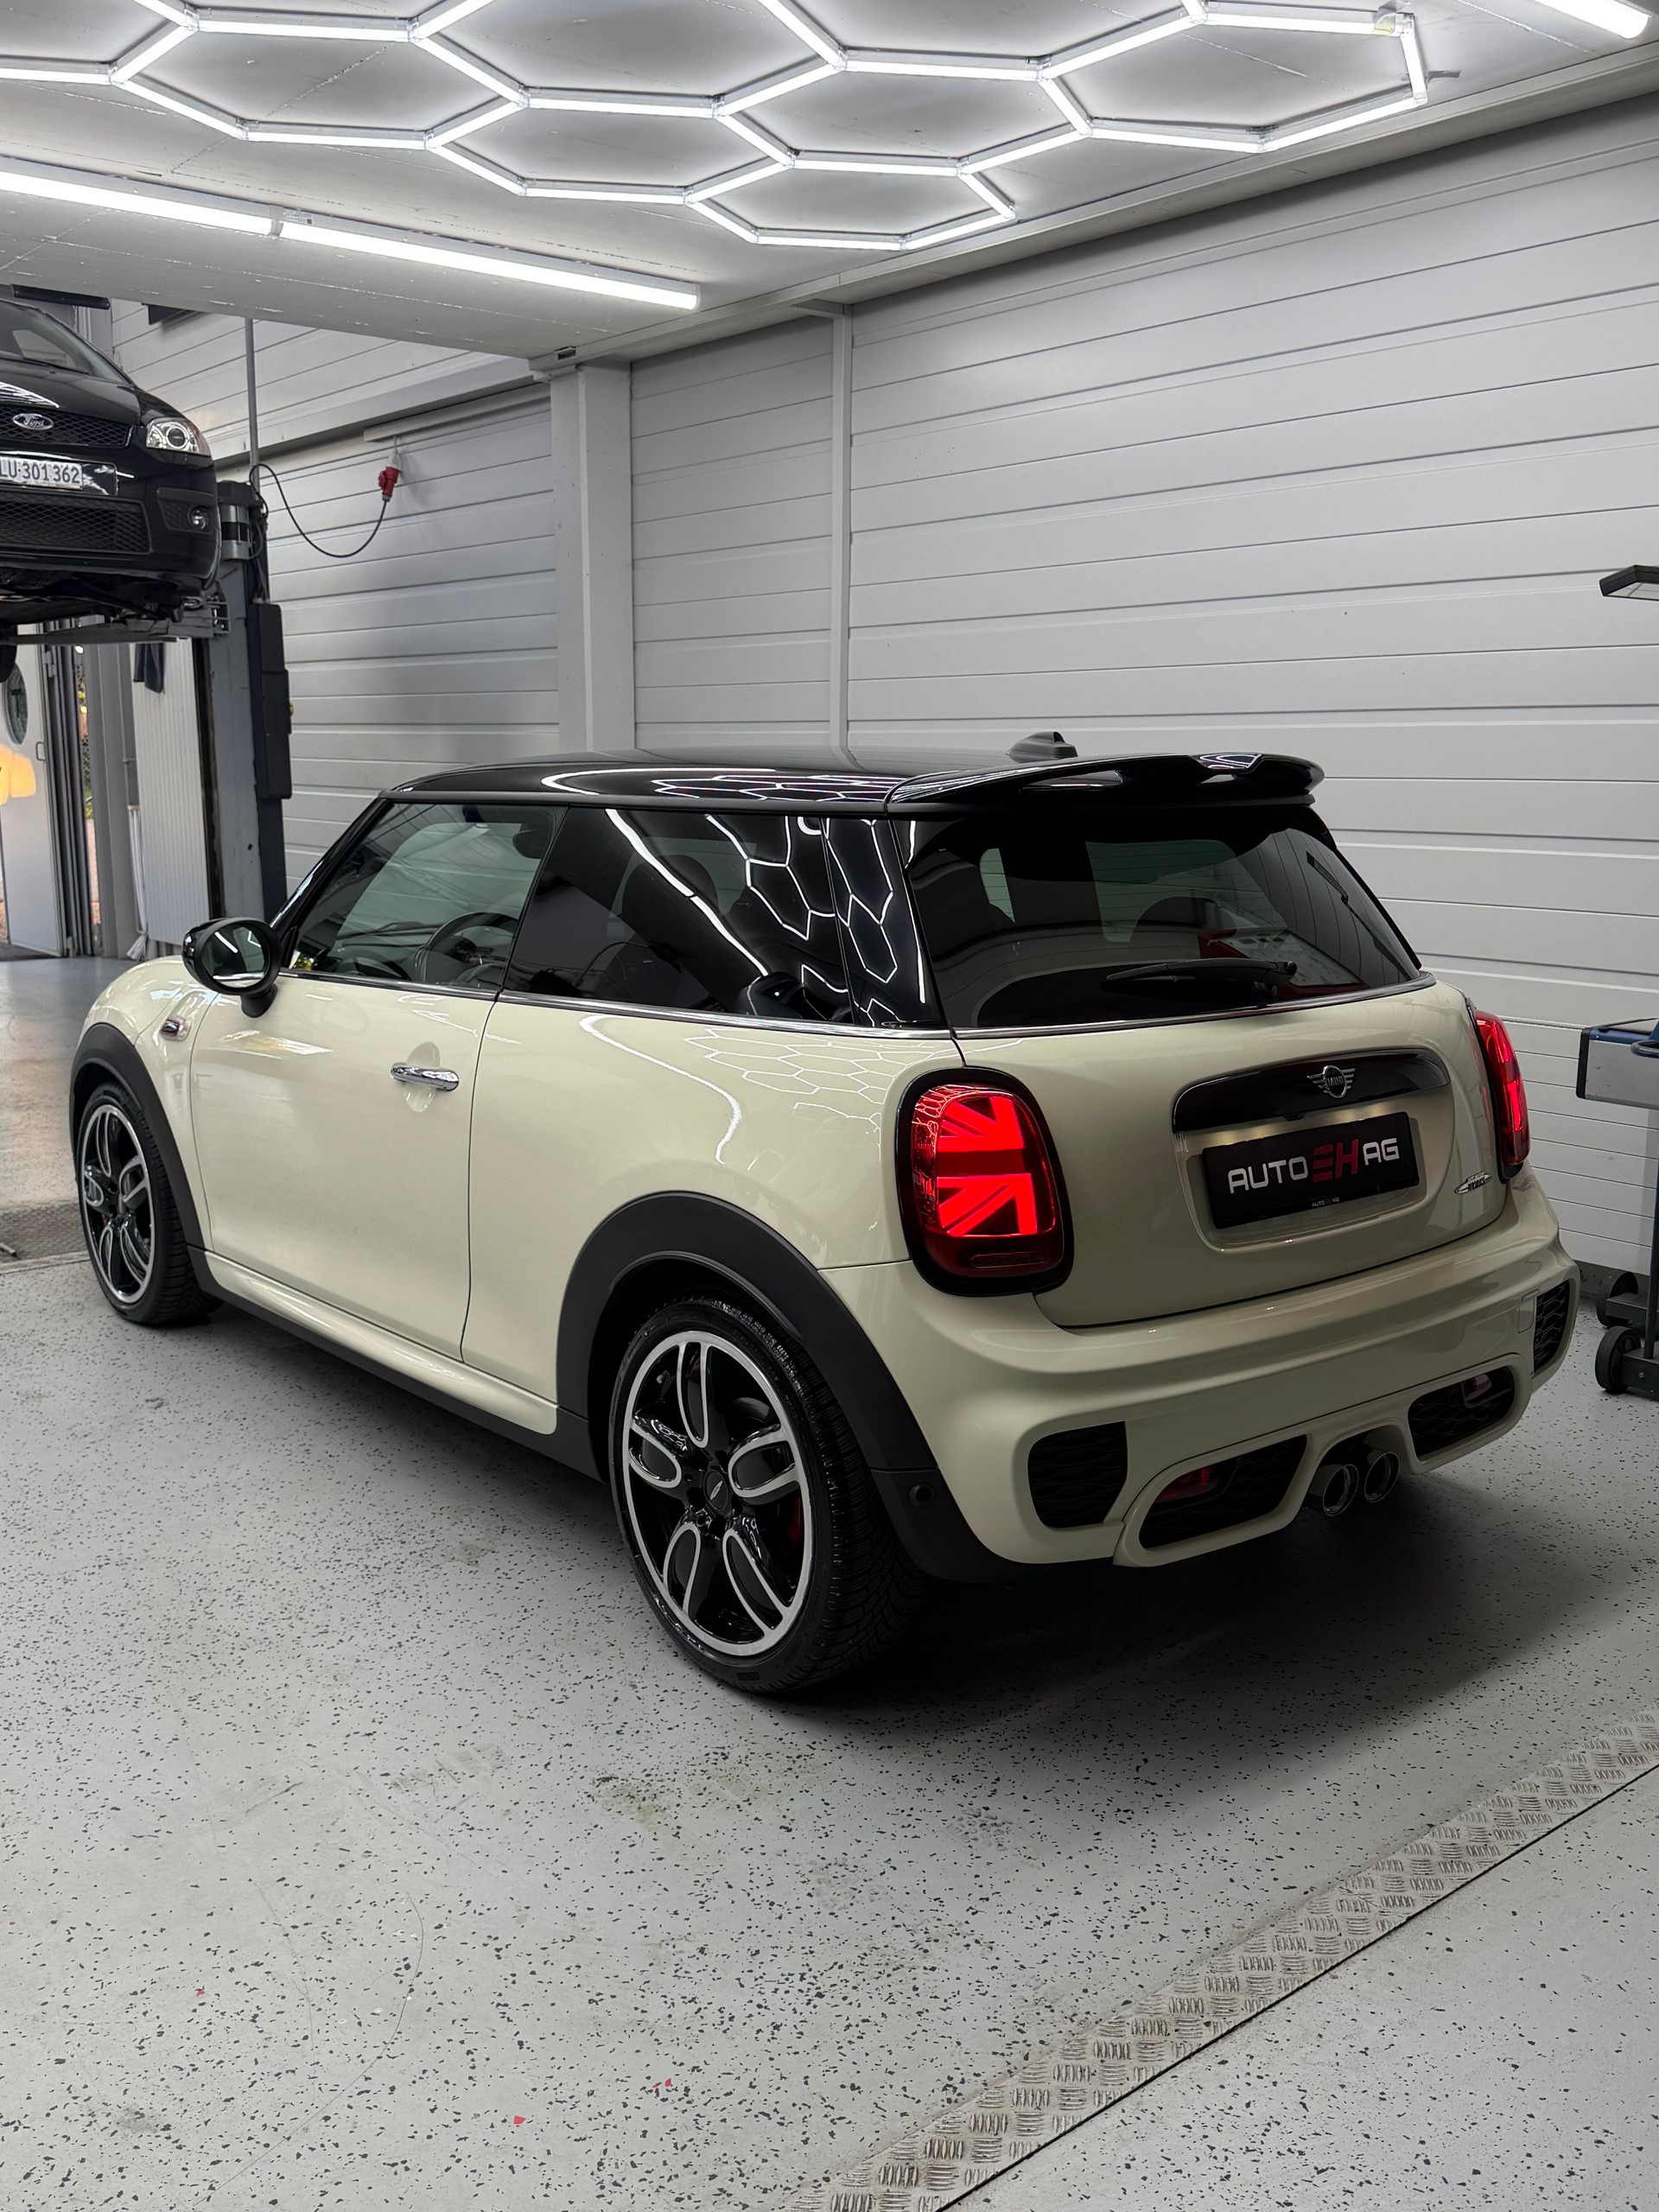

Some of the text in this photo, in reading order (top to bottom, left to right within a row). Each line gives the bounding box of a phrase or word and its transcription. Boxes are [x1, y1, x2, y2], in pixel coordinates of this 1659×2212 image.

[1327, 1075, 1344, 1086] MINI
[1227, 1137, 1400, 1194] AUTO EH AG
